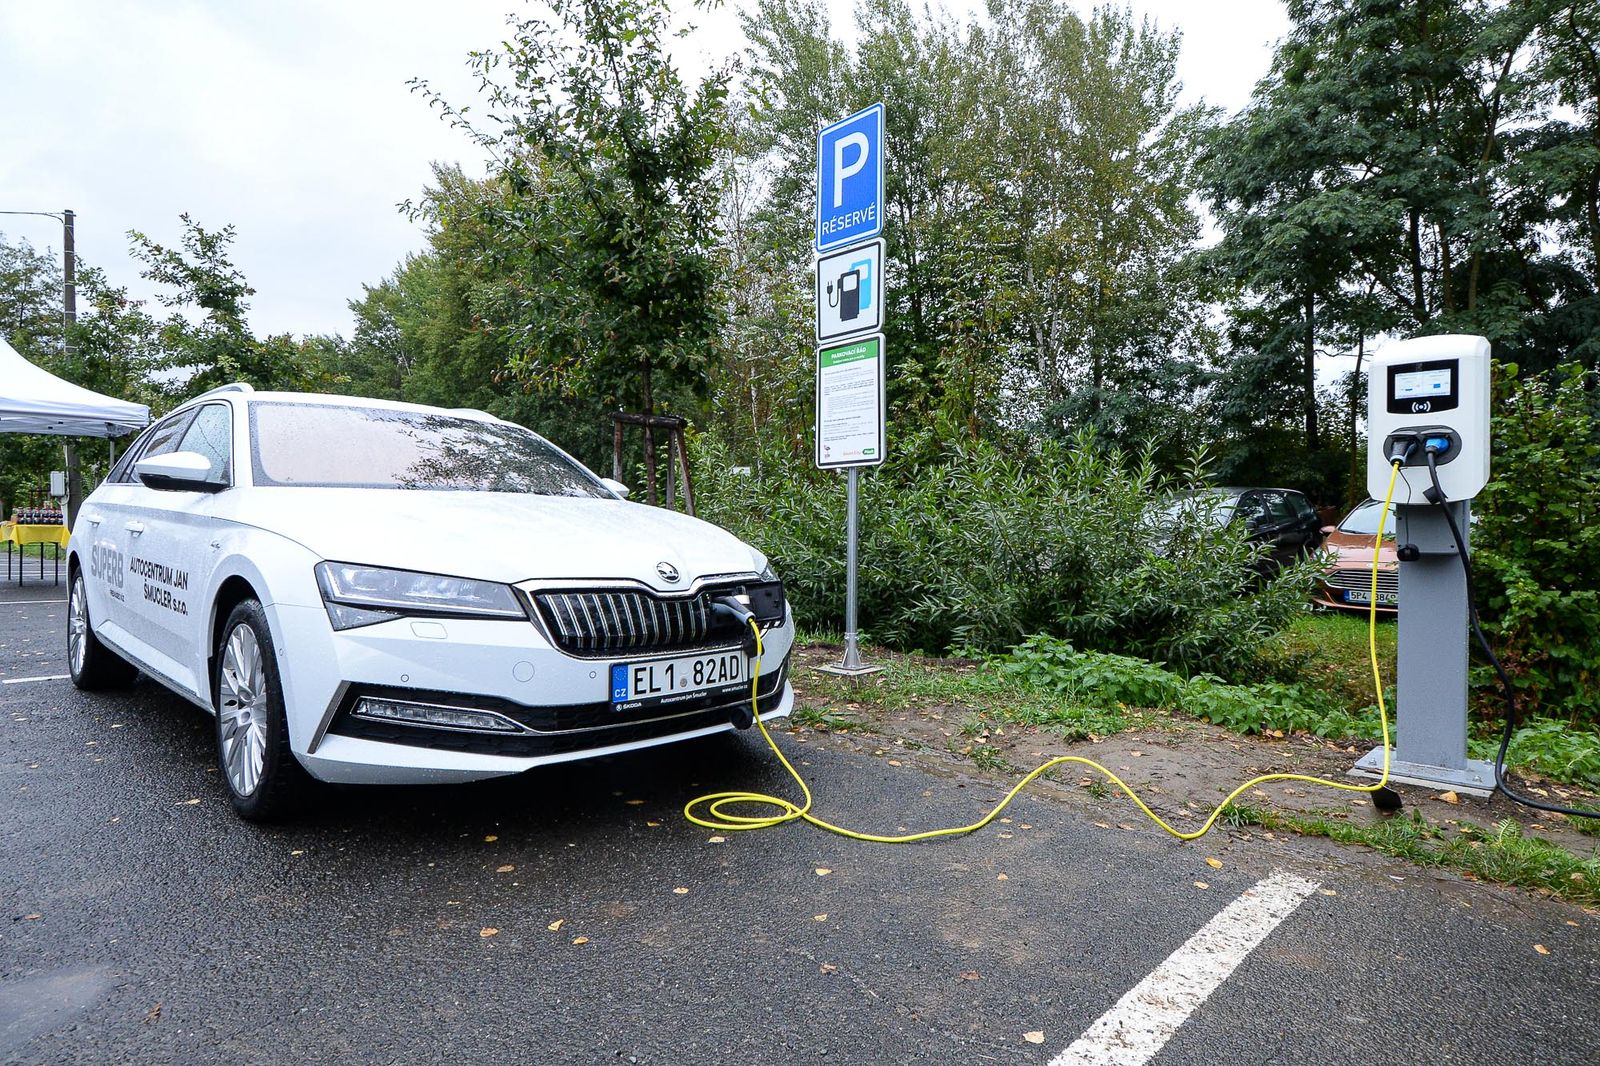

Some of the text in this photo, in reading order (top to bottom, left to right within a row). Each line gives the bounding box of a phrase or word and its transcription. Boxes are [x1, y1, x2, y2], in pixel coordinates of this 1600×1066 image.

[833, 131, 869, 209] P
[821, 202, 876, 236] RÉSERVÉ
[91, 545, 124, 589] SUPERB
[130, 557, 189, 590] AUTOCENTRUM JAN
[144, 579, 172, 609] ŠMUCLER
[173, 598, 189, 616] s.r.o.
[1351, 591, 1367, 600] 5P4
[614, 688, 626, 698] CZ
[634, 655, 740, 696] EL1 82AD
